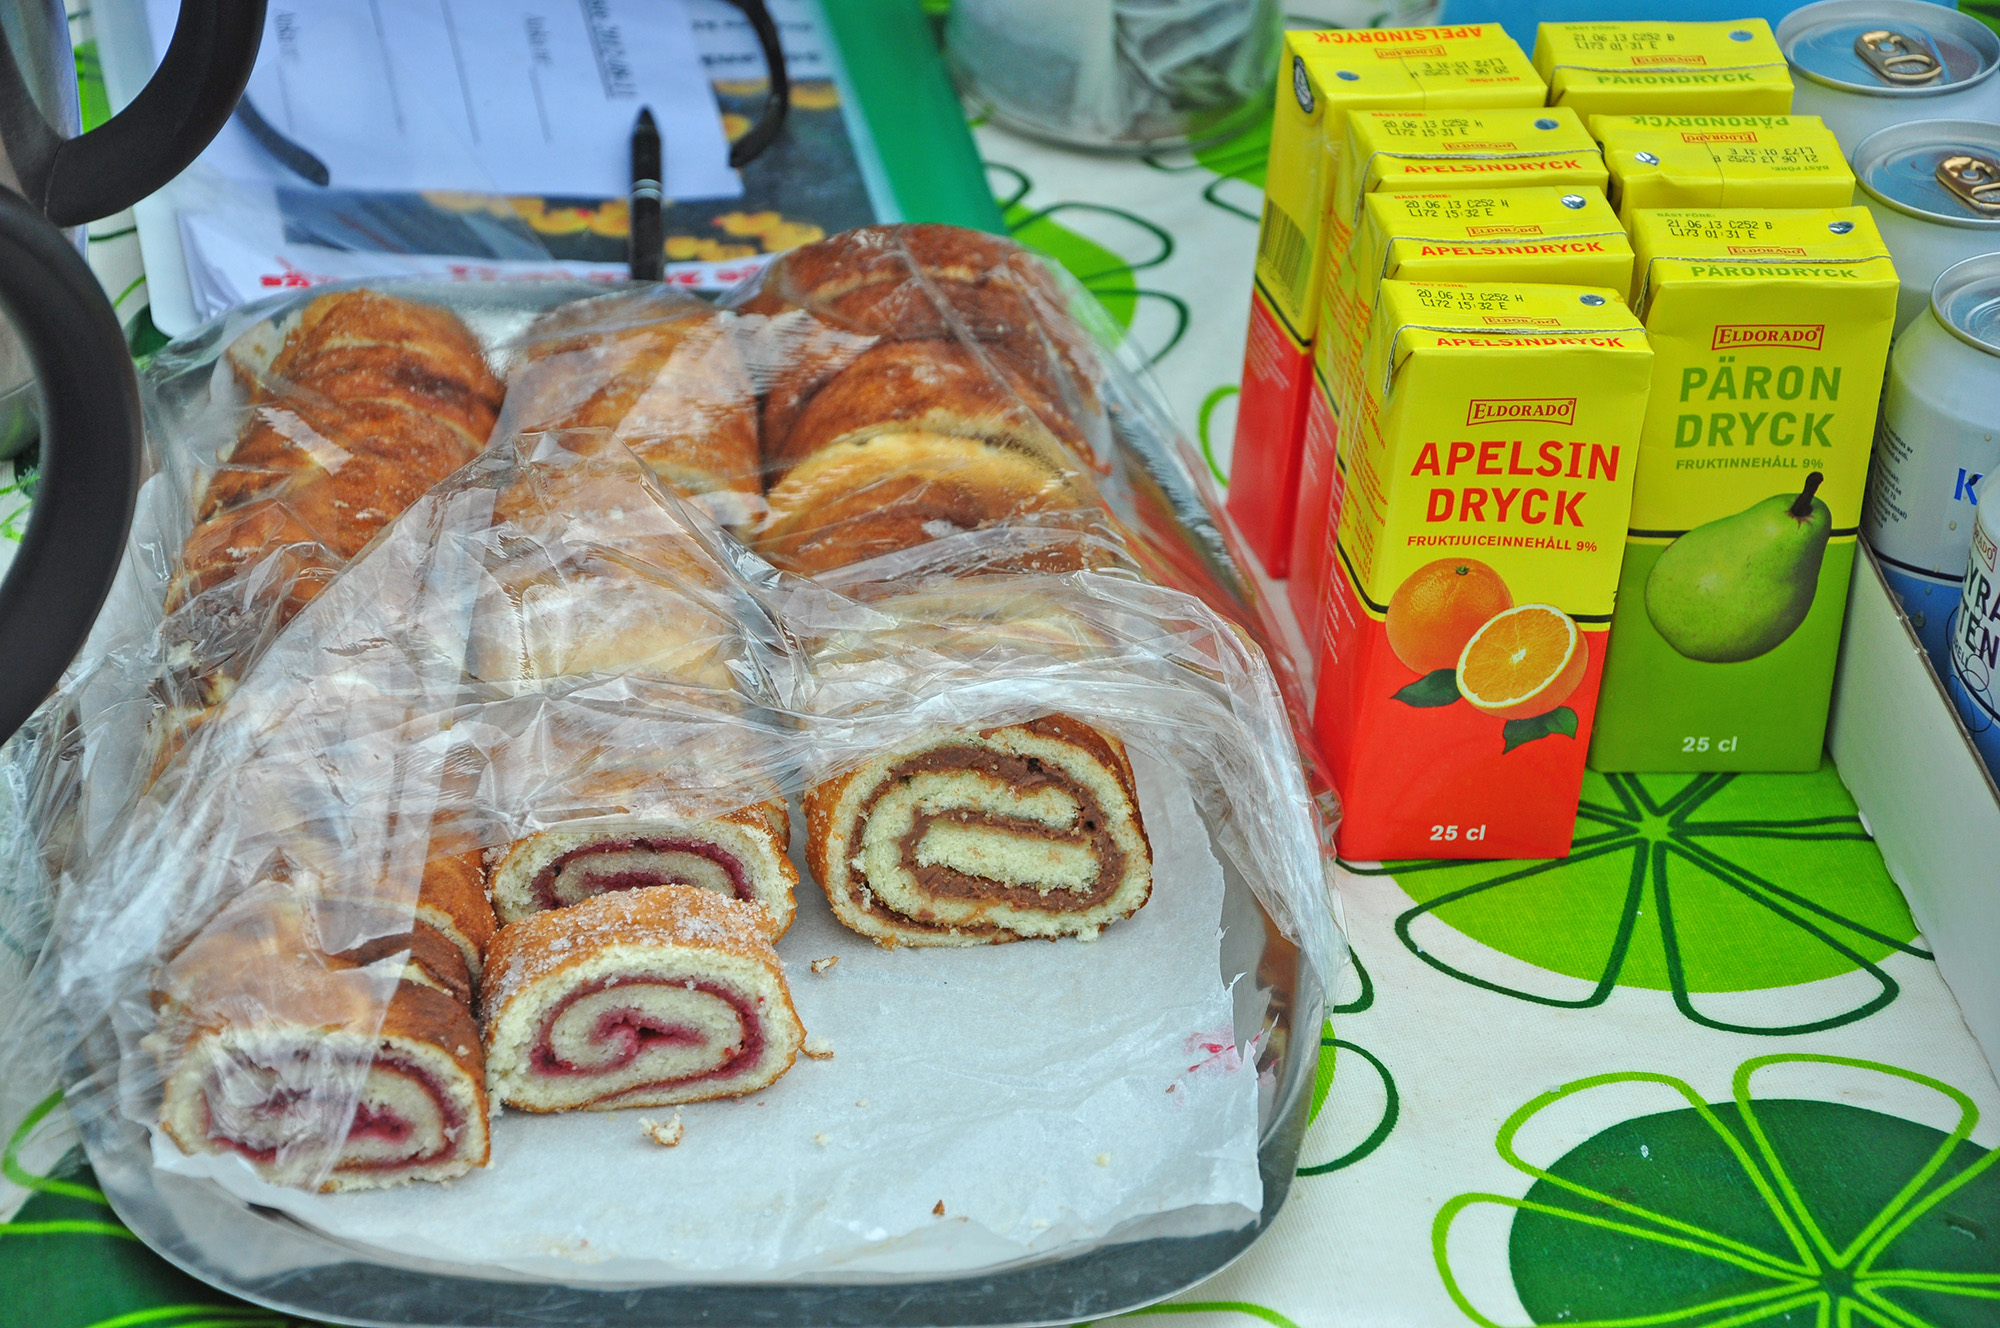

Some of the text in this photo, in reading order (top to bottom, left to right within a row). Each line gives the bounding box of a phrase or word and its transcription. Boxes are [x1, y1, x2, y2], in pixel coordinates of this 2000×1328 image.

[1316, 26, 1482, 44] APELSINDRYCK
[1597, 72, 1755, 84] PÄRONDRYCK
[1442, 119, 1470, 128] C252
[1632, 116, 1790, 129] PÄRONDRYCK
[1387, 127, 1416, 136] L172
[1461, 128, 1468, 136] E
[1404, 160, 1583, 173] APELSINDRYCK
[1467, 199, 1496, 208] C252
[1409, 209, 1438, 218] L172
[1485, 208, 1494, 217] E
[1728, 220, 1759, 230] C252
[1765, 221, 1773, 230] B
[1670, 228, 1699, 238] L173
[1748, 230, 1757, 239] E
[1421, 241, 1605, 256] APELSINDRYCK
[1691, 265, 1858, 278] PÄRONDRYCK
[1421, 298, 1451, 309] L172
[1500, 301, 1508, 310] E
[1480, 293, 1509, 302] C252
[1515, 294, 1524, 302] H
[1437, 337, 1625, 348] APELSINDRYCK
[1718, 327, 1821, 345] ELDORADO
[1679, 356, 1842, 402] PÄRON
[1472, 401, 1573, 420] ELDORADO
[1674, 411, 1836, 448] DRYCK
[1410, 440, 1621, 482] APELSIN
[1676, 455, 1824, 470] FRUKTINNEHÅLL 9%
[1425, 487, 1588, 527] DRYCK
[1407, 533, 1598, 552] FRUKTJUICEINNEHÅLL 9%
[1682, 736, 1738, 752] 25 cl
[1429, 825, 1487, 841] 25 cl
